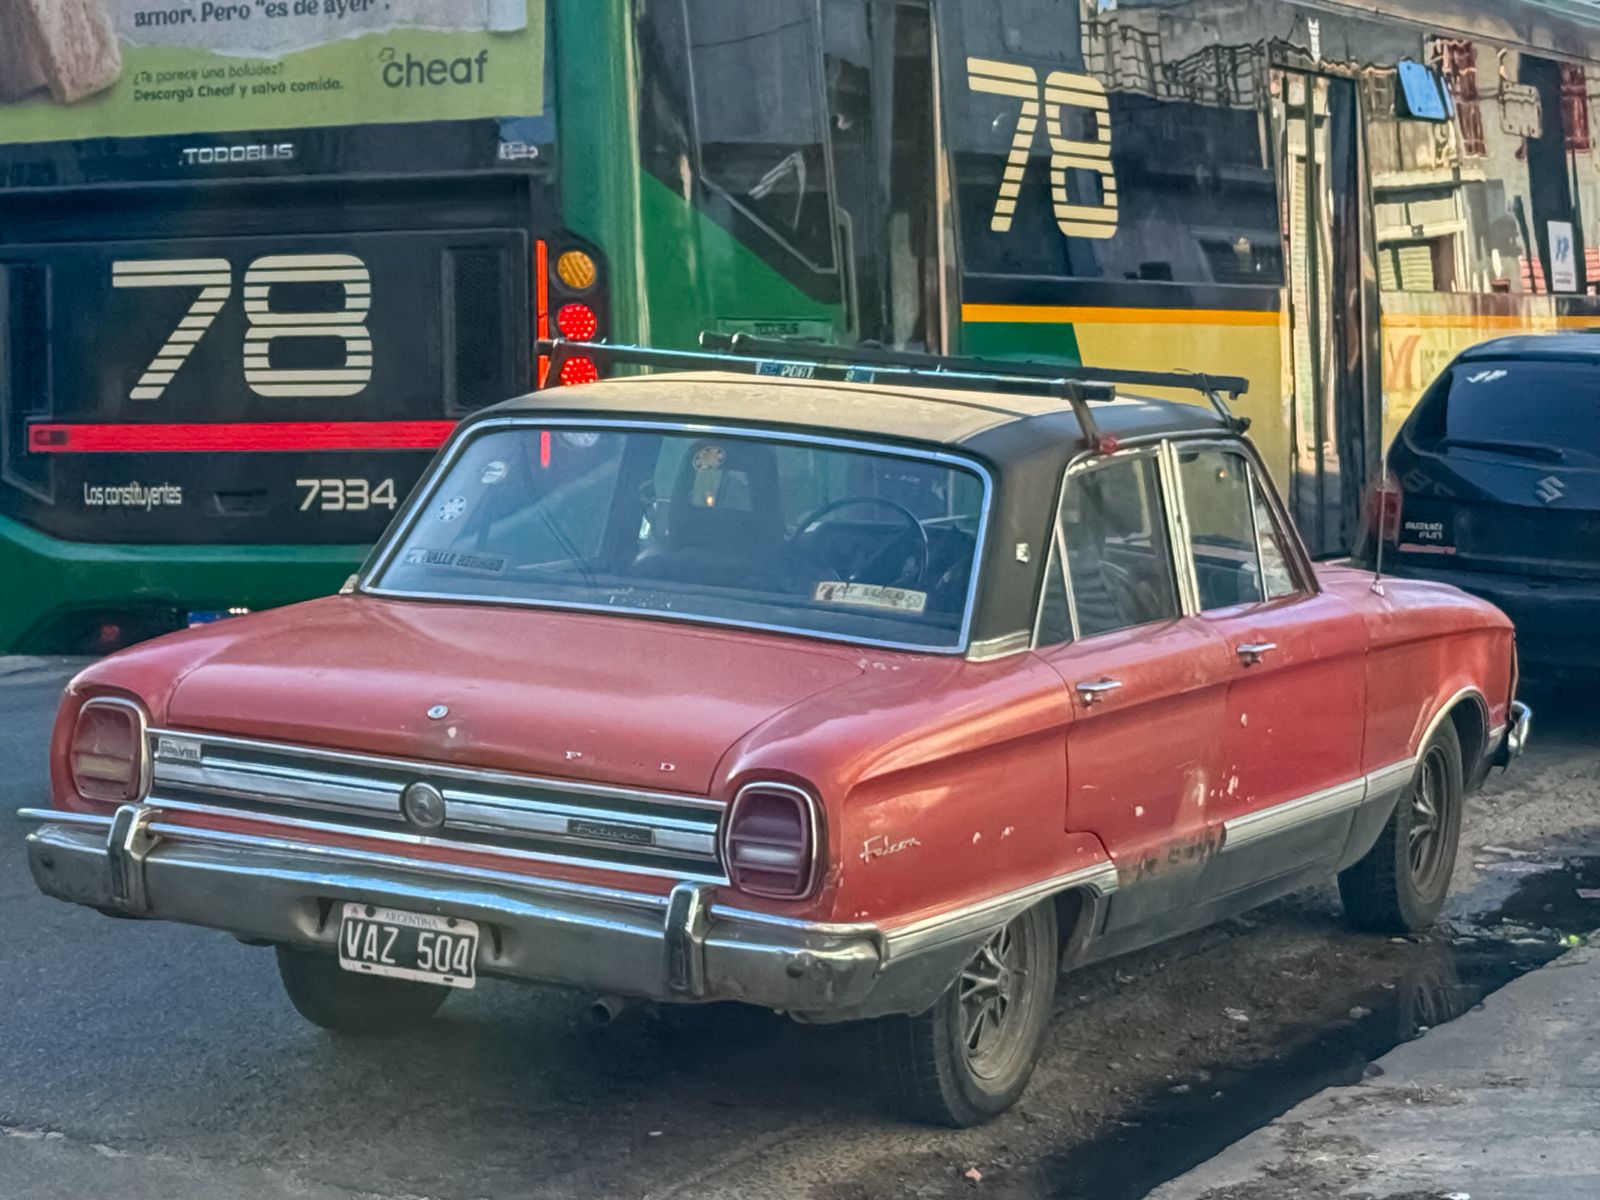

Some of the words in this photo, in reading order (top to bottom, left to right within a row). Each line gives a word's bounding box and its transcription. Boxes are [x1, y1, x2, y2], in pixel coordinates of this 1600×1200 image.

[134, 9, 197, 27] amor.
[200, 1, 251, 22] Pero
[293, 0, 319, 15] de
[156, 69, 198, 84] parece
[201, 68, 224, 79] una
[228, 62, 284, 78] boludez?
[382, 50, 488, 88] cheaf
[197, 82, 235, 97] Cheaf
[239, 84, 248, 98] y
[290, 76, 344, 92] comida.
[966, 57, 1119, 239] 78
[112, 253, 373, 401] 78
[83, 482, 103, 506] Los
[296, 478, 397, 511] 7334
[859, 835, 921, 864] Falcon
[384, 911, 438, 928] ARGENTINA
[346, 920, 400, 964] VAZ
[416, 931, 470, 975] 504
